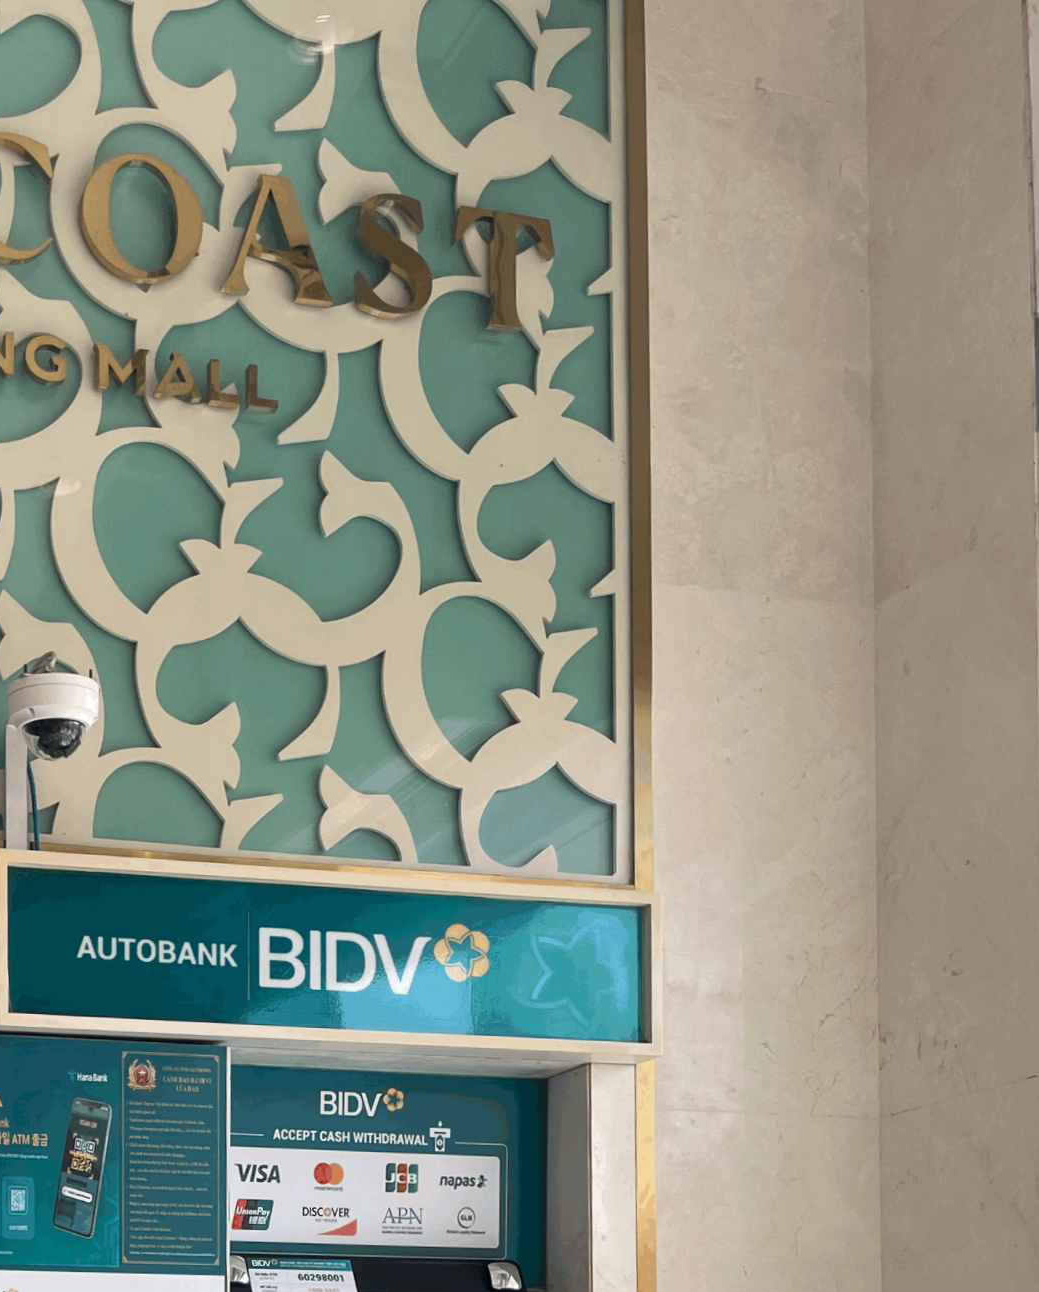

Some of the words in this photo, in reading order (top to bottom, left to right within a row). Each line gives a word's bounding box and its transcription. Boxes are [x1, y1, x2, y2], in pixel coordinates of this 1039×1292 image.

[94, 343, 279, 413] MALL
[76, 935, 238, 968] AUTOBANK
[259, 927, 431, 995] BIDV
[77, 1073, 93, 1082] Hana
[94, 1073, 108, 1082] Bank
[320, 1091, 382, 1117] BIDV
[12, 1134, 30, 1145] ATM
[32, 1134, 48, 1146] 출금
[273, 1129, 317, 1141] ACCEPT
[320, 1130, 350, 1143] CASH
[353, 1132, 428, 1146] WITHDRAWAL
[234, 1164, 281, 1183] VISA
[440, 1176, 476, 1190] napas
[236, 1206, 270, 1219] UnionPay
[302, 1207, 350, 1218] DISCOVER
[382, 1207, 423, 1224] APN
[298, 1273, 344, 1282] 60298001
